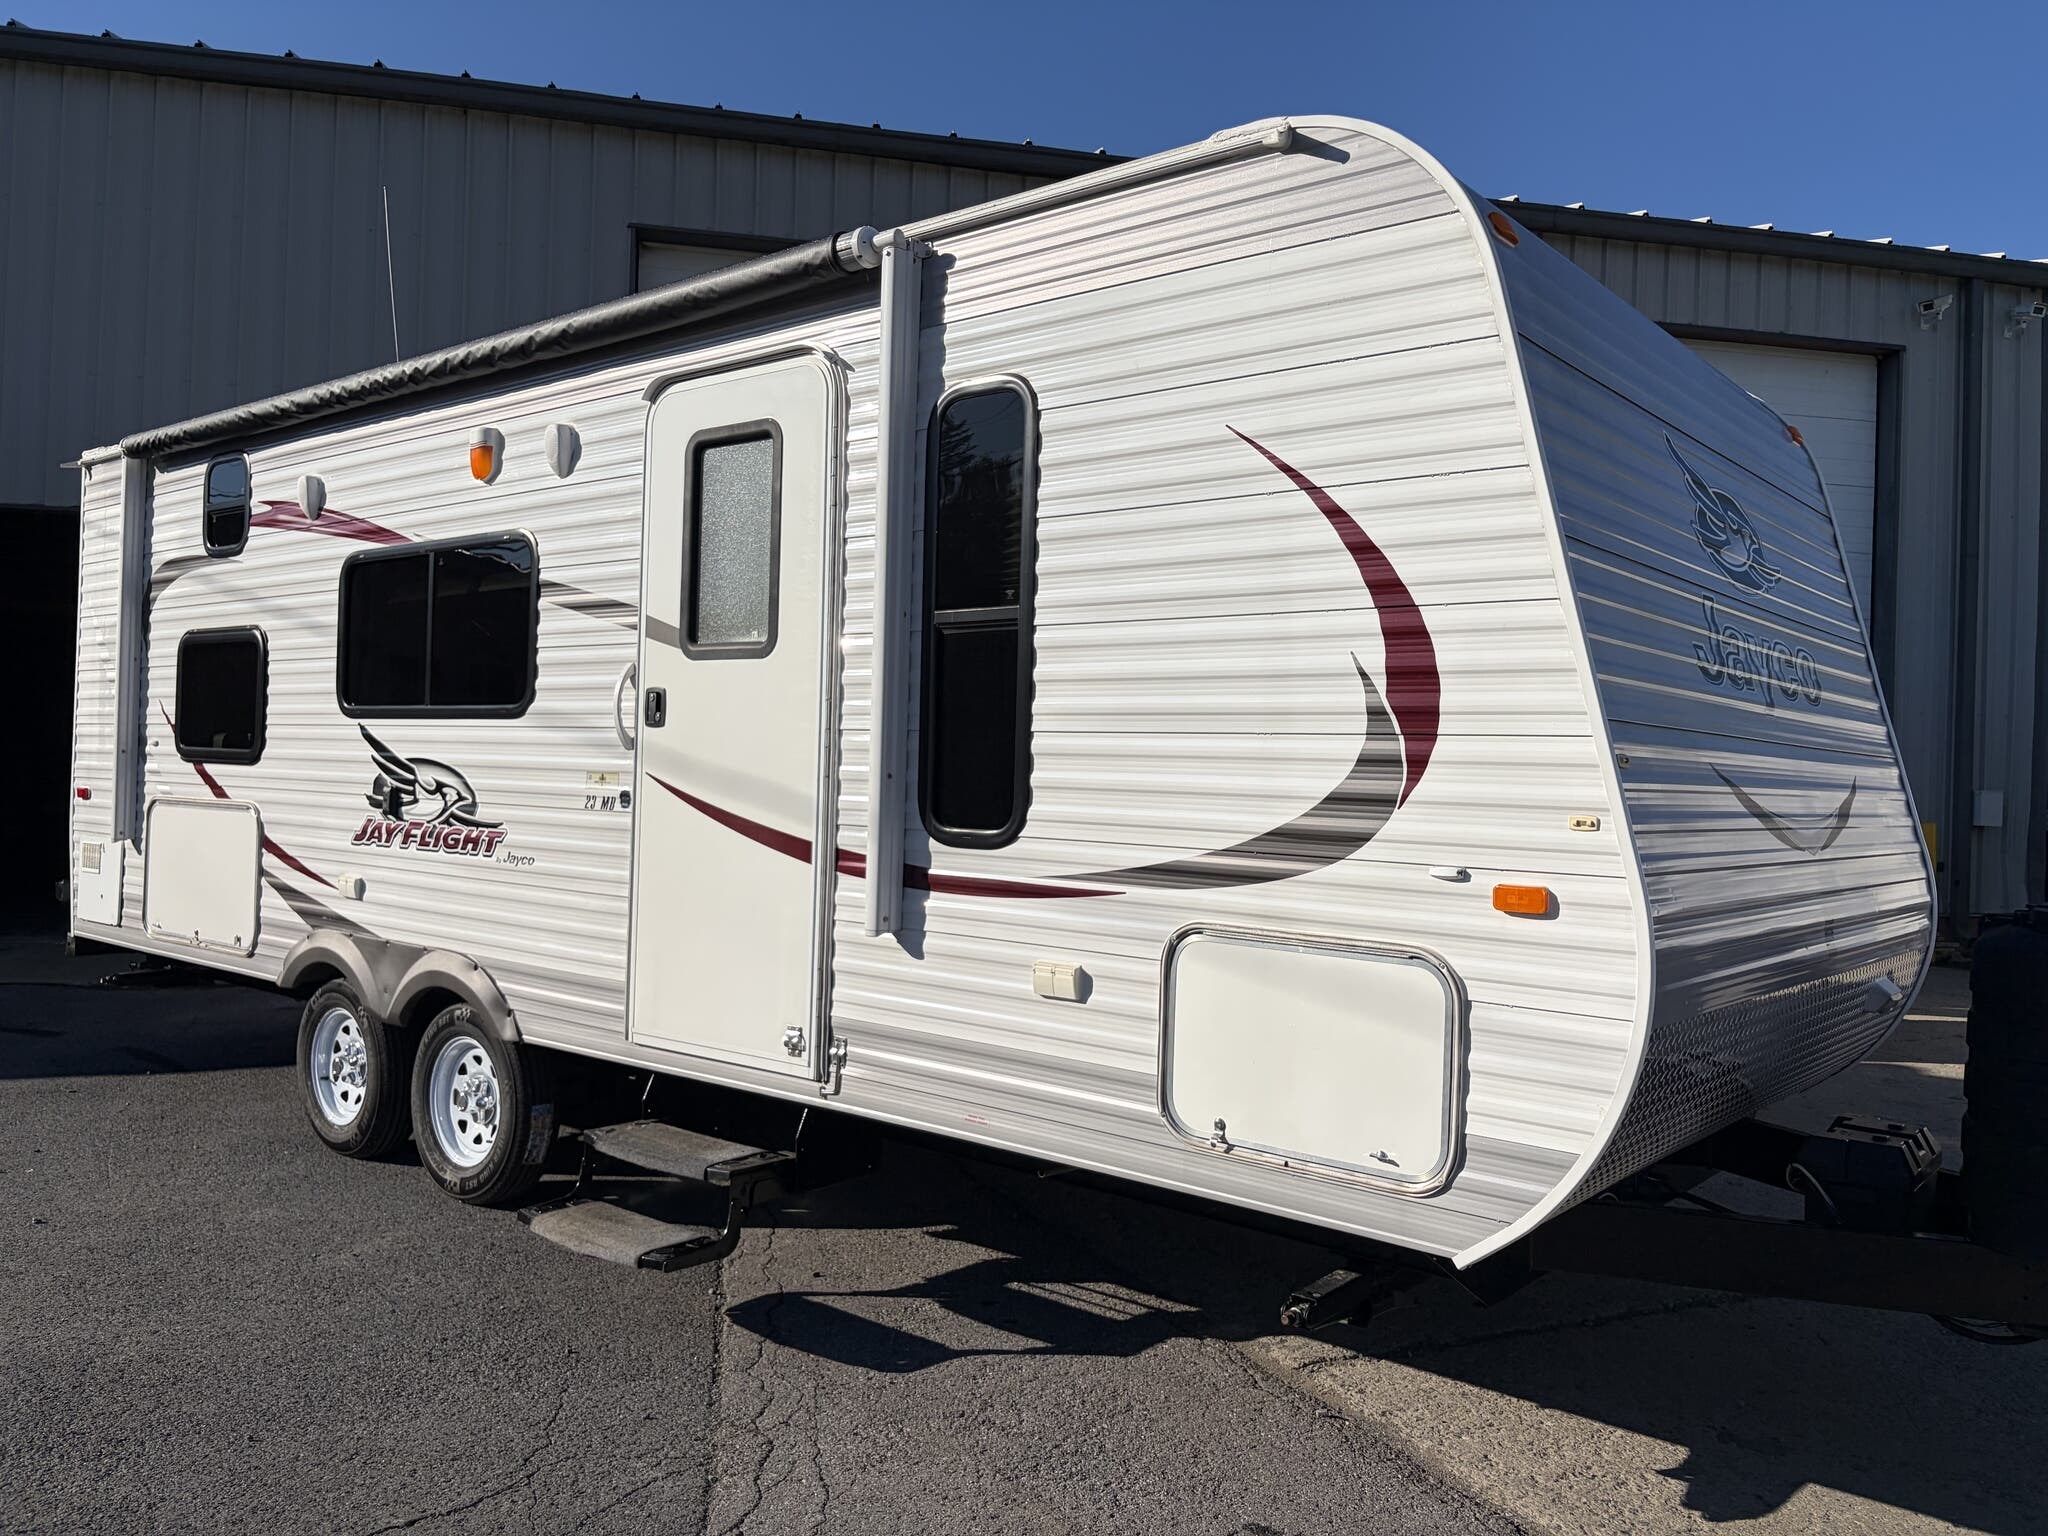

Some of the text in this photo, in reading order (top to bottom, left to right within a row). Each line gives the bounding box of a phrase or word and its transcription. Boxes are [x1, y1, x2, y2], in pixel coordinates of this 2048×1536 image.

[1692, 593, 1822, 714] Jayco
[584, 795, 597, 810] 23
[352, 816, 507, 855] JAY FLIGHT
[503, 851, 535, 867] Jayco
